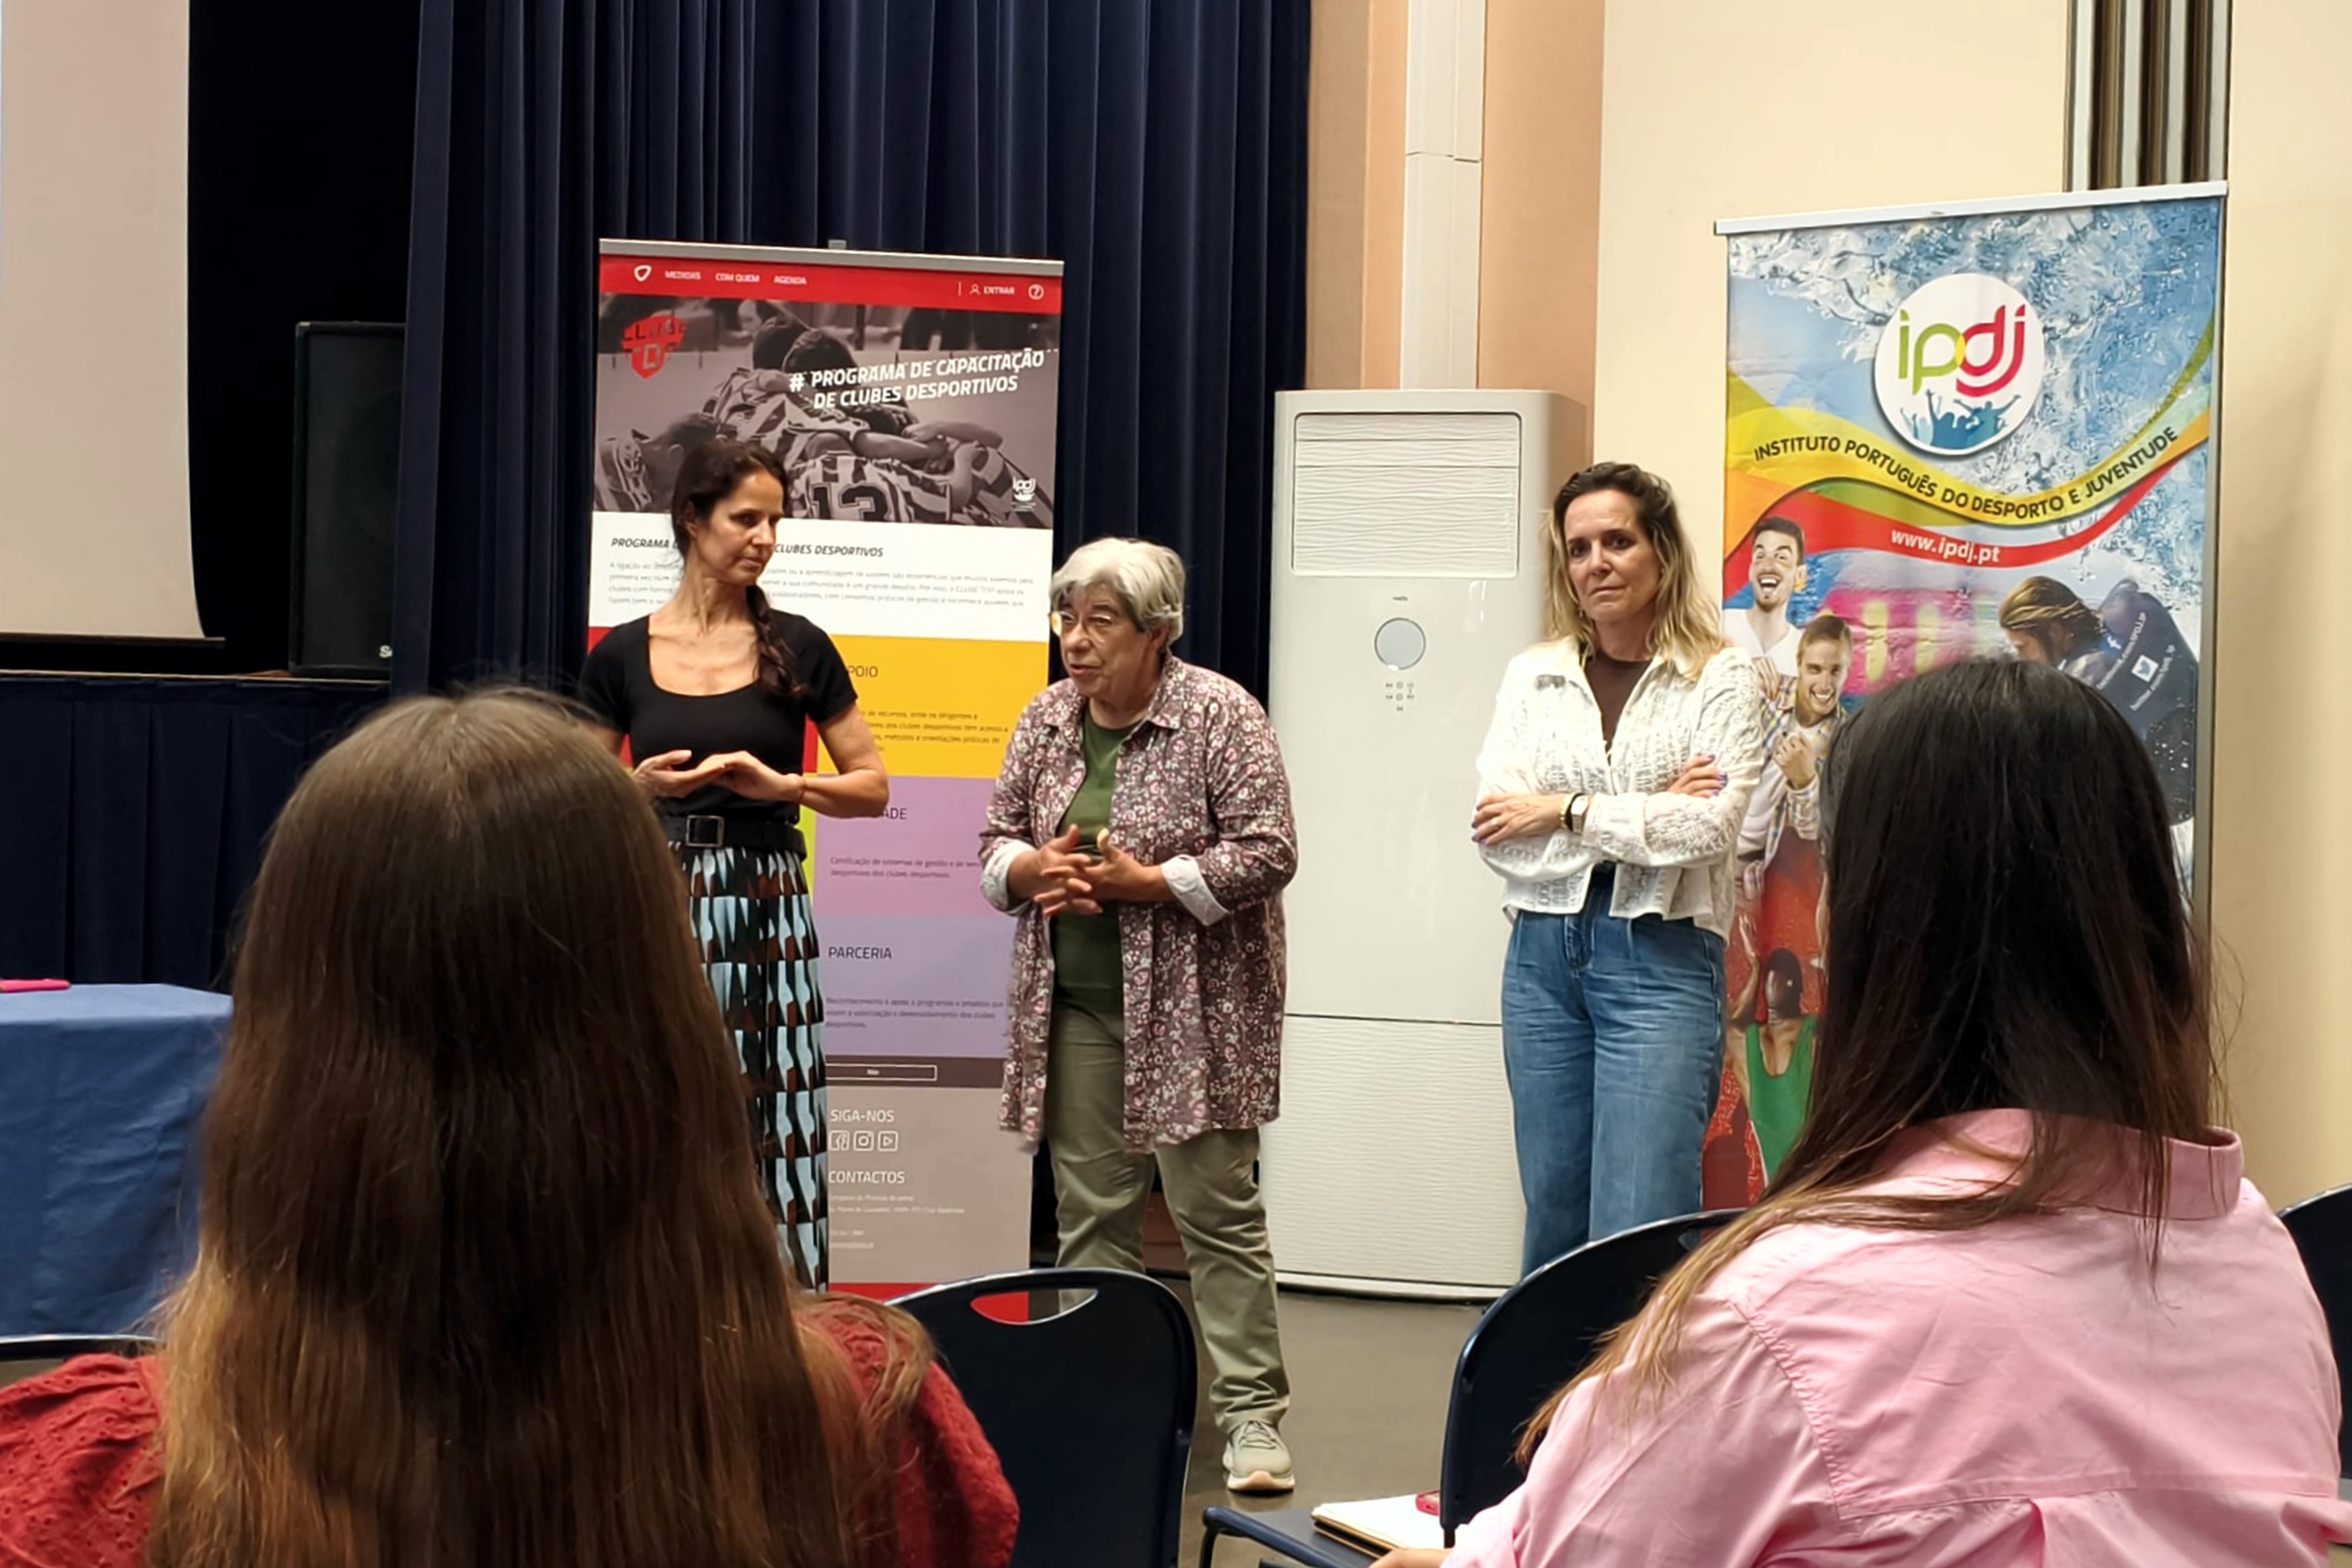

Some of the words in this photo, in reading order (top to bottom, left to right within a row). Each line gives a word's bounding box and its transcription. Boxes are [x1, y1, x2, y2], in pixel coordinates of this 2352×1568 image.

[716, 273, 734, 281] COM
[735, 274, 759, 282] QUEM
[774, 276, 806, 285] AGENDA
[1898, 304, 2025, 397] ipdj
[789, 373, 805, 392] #
[811, 363, 905, 387] PROGRAMA
[911, 360, 932, 378] DE
[936, 348, 1044, 375] CAPACITAÇÃO
[813, 393, 835, 409] DE
[840, 386, 902, 406] CLUBES
[906, 376, 1018, 401] DESPORTIVOS
[1755, 436, 1841, 461] INSTITUTO
[1844, 440, 1938, 497] PORTUGUÊS
[1941, 488, 1968, 508] DO
[1972, 497, 2065, 519] DESPORTO
[2068, 490, 2081, 505] E
[2085, 426, 2178, 498] JUVENTUDE
[611, 538, 670, 548] PROGRAMA
[1891, 530, 2000, 565] www.ipdj.pt
[775, 544, 812, 554] CLUBES
[814, 545, 884, 557] DESPORTIVOS
[848, 665, 879, 678] POIO
[828, 946, 892, 959] PARCERIA
[831, 1109, 894, 1122] SIGA-NOS
[828, 1170, 905, 1183] CONTACTOS
